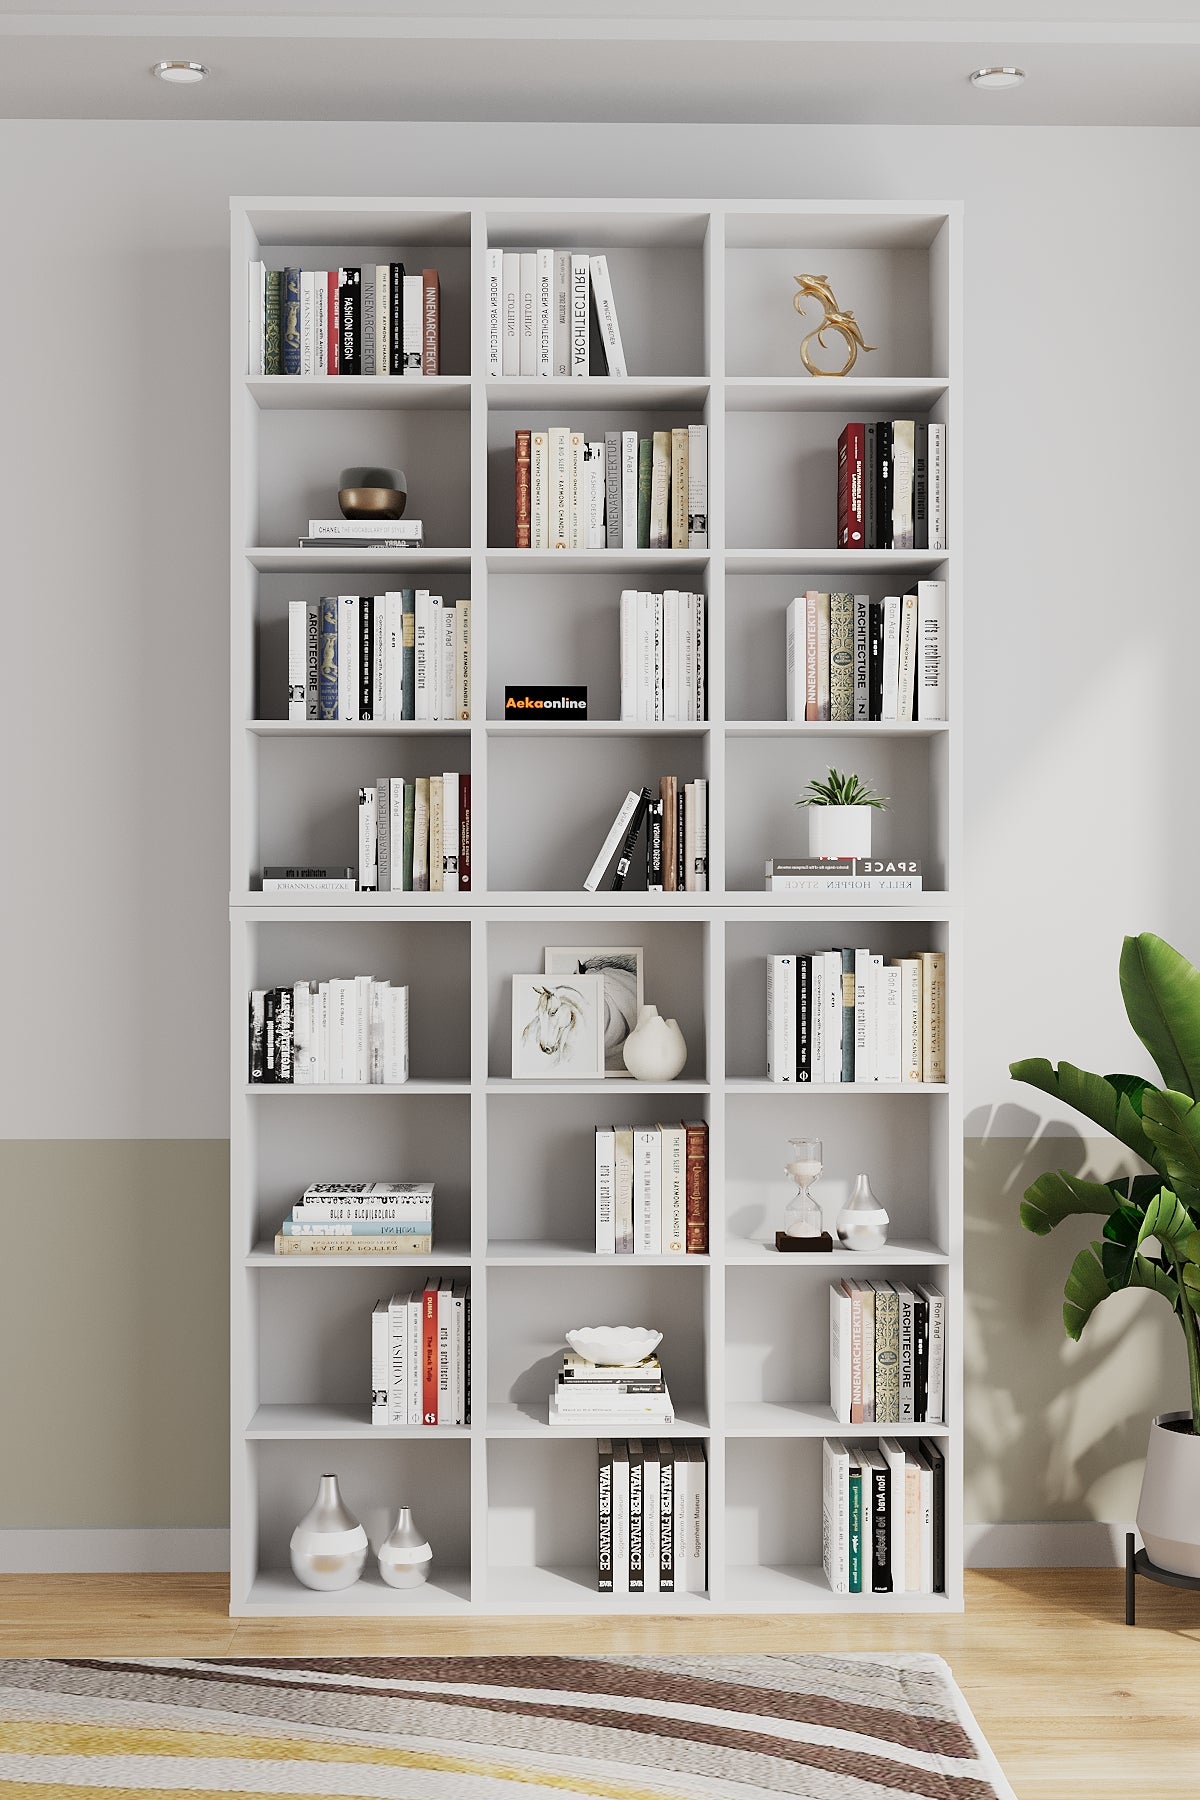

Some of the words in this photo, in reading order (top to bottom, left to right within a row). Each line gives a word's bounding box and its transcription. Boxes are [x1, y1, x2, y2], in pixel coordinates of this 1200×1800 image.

[343, 297, 354, 331] FASHION
[364, 282, 375, 376] INNENARCHITEKTU
[425, 287, 437, 376] INNENARCHITEKTU
[343, 331, 354, 360] DESIGN
[626, 437, 634, 454] Ron
[626, 455, 634, 473] Arad
[607, 439, 618, 538] INNENARCHITEKTUR
[445, 613, 454, 628] Ron
[888, 603, 897, 619] Ron
[888, 620, 897, 639] Arad
[924, 619, 941, 633] arts
[309, 613, 318, 692] ARCHITECTURE
[418, 626, 426, 640] arts
[445, 630, 454, 647] Arad
[807, 599, 817, 704] INNENARCHITEKTUR
[857, 603, 866, 689] ARCHITECTURE
[418, 650, 426, 690] architecture
[924, 645, 941, 687] architecture
[378, 785, 388, 877] INNENARCHITEKTUR
[857, 985, 865, 998] arts
[888, 972, 897, 987] Ron
[888, 989, 897, 1006] Arad
[857, 1009, 865, 1049] architecture
[600, 1186, 611, 1223] architecture
[393, 1308, 403, 1333] THE
[934, 1302, 942, 1318] Ron
[934, 1320, 942, 1339] Arad
[440, 1327, 449, 1340] arts
[853, 1300, 861, 1405] INNENARCHITEKTUR
[902, 1302, 911, 1388] ARCHITECTURE
[393, 1334, 403, 1386] FASHION
[440, 1351, 449, 1391] architecture
[599, 1465, 611, 1516] WALTER
[630, 1465, 642, 1516] WALTER
[661, 1465, 672, 1516] WALTER
[599, 1516, 611, 1571] FINANCE
[630, 1516, 642, 1571] FINANCE
[661, 1516, 672, 1571] FINANCE
